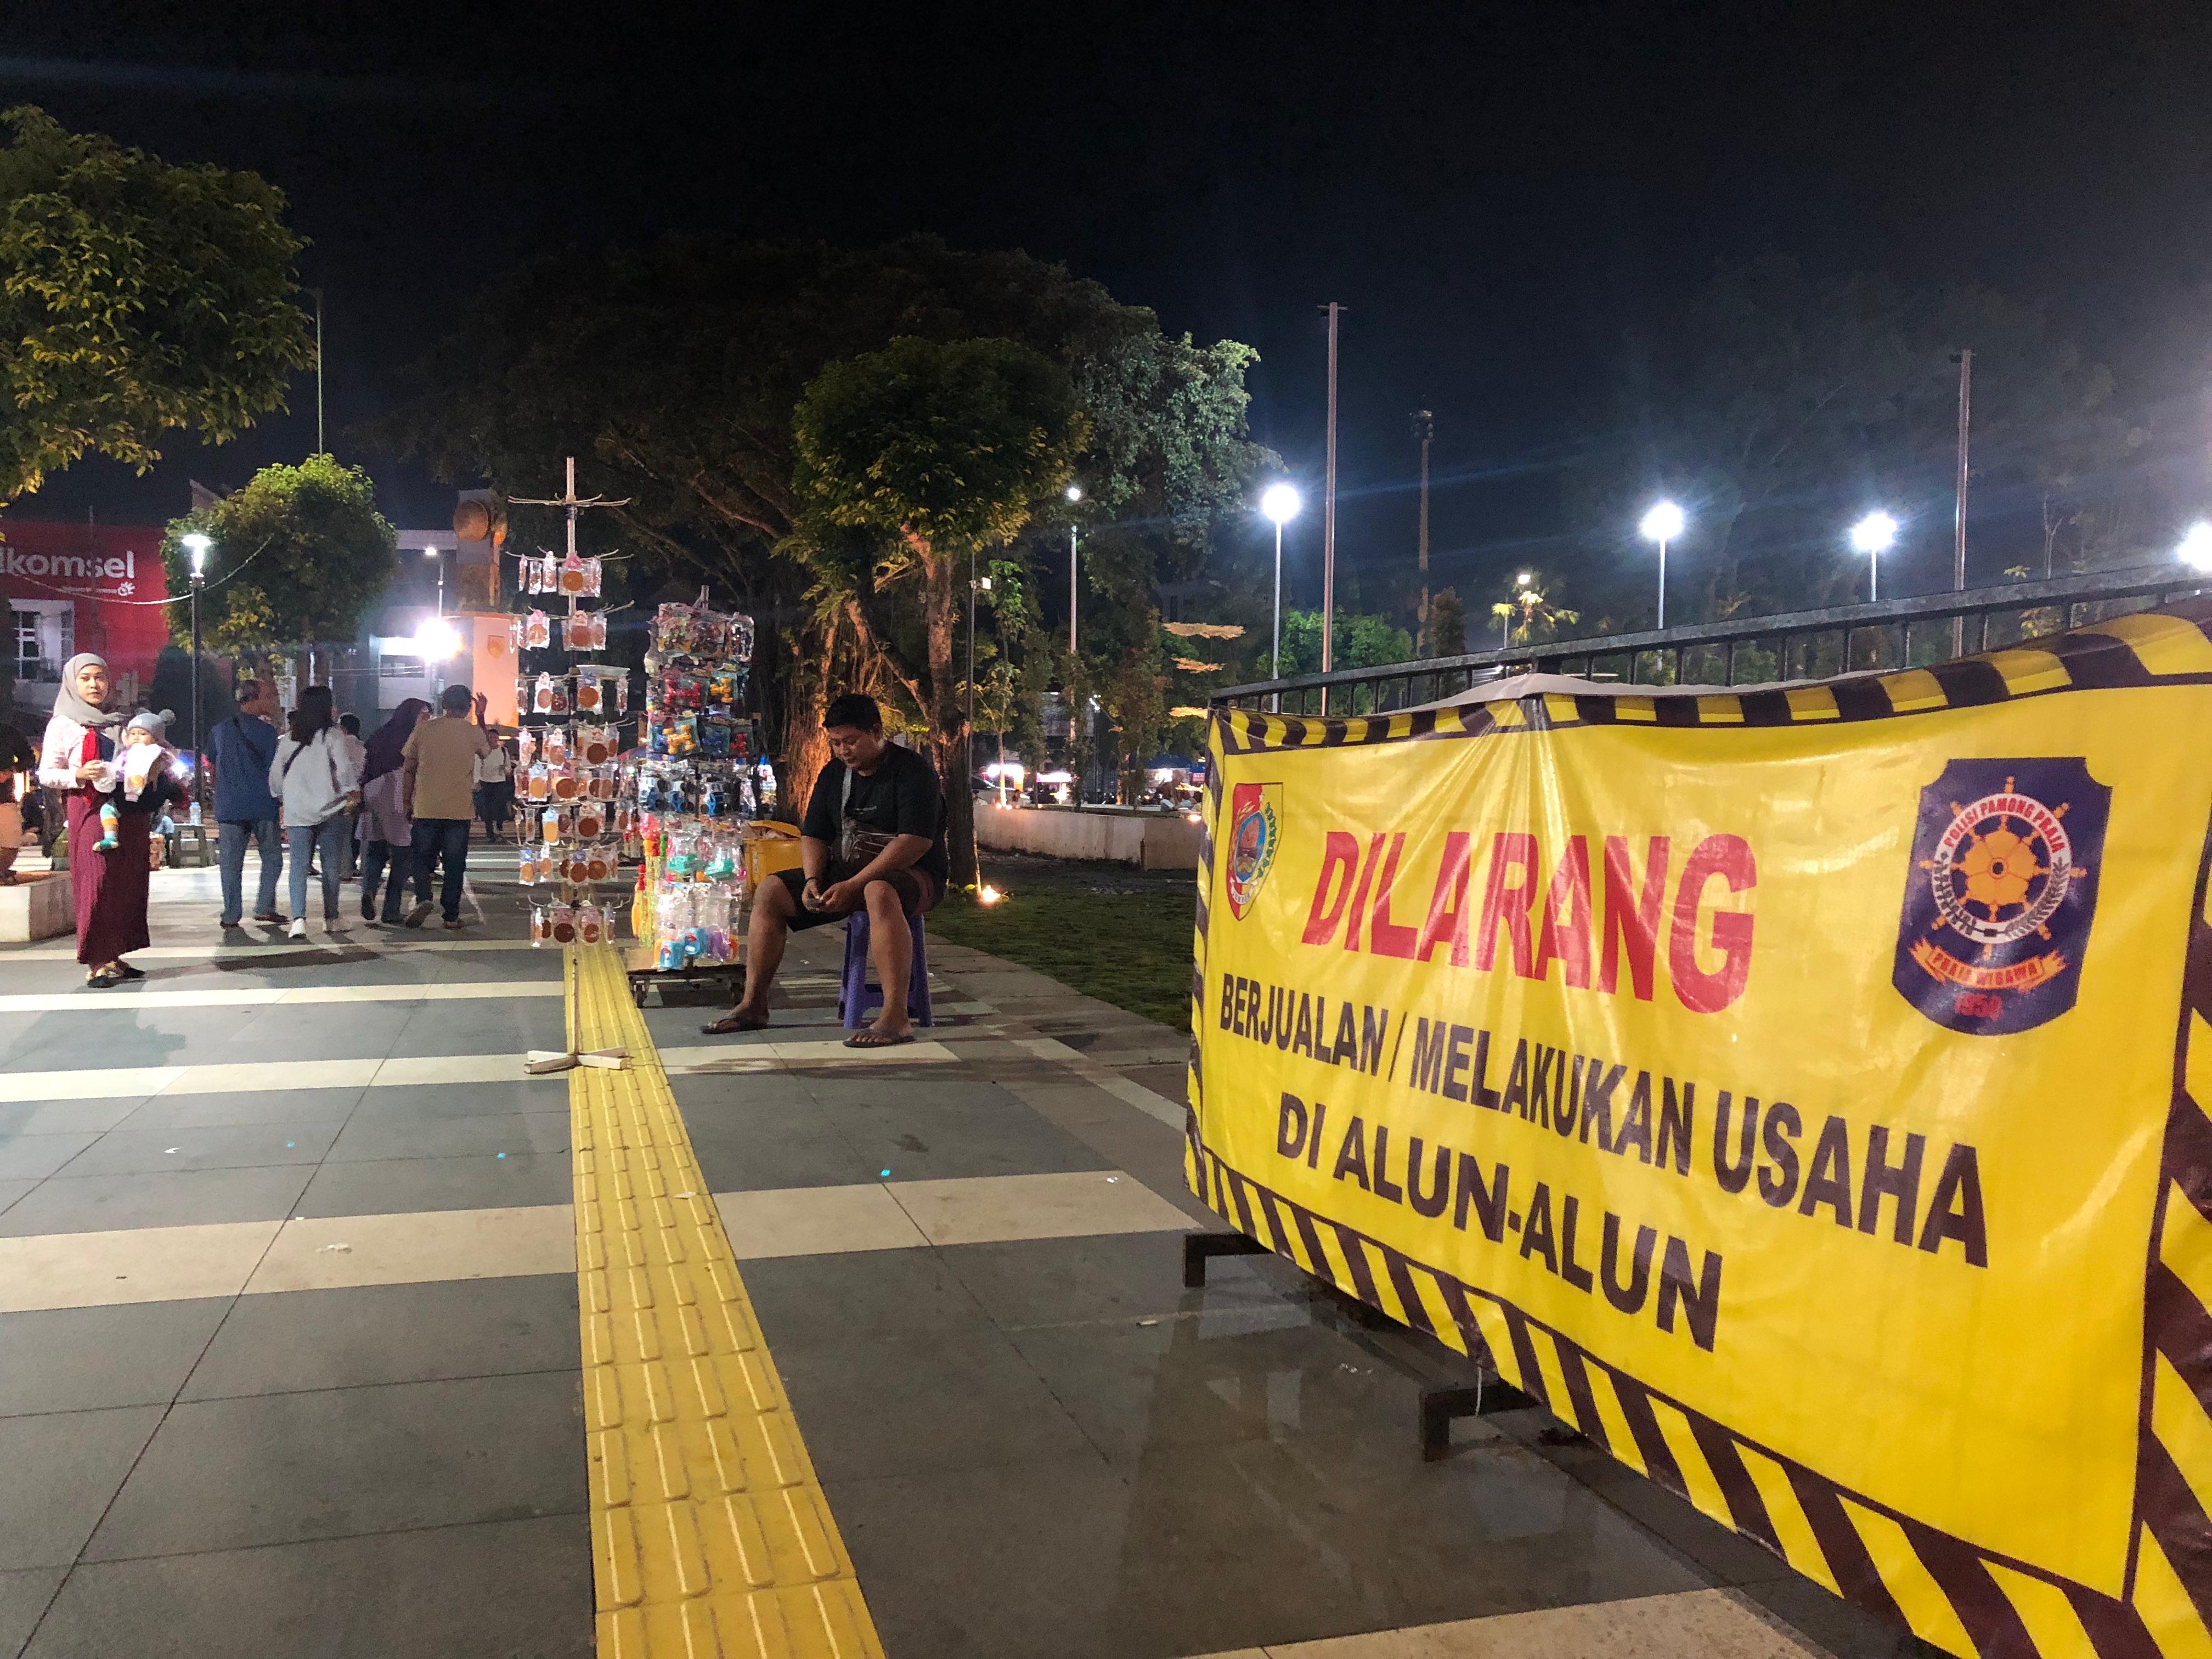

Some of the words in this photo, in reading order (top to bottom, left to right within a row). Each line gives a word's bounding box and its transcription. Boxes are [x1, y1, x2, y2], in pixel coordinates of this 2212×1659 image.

[1302, 831, 1757, 1014] DILARANG
[1944, 808, 1979, 848] POLISI
[1979, 798, 2035, 817] PAMONG
[2033, 810, 2065, 853] PRAJA
[1220, 973, 1389, 1076] BERJUALAN
[1409, 1016, 1696, 1177] MELAKUKAN
[1713, 1090, 1989, 1269] USAHA
[1277, 1092, 1326, 1170] DI
[1333, 1115, 1723, 1353] ALUN-ALUN
